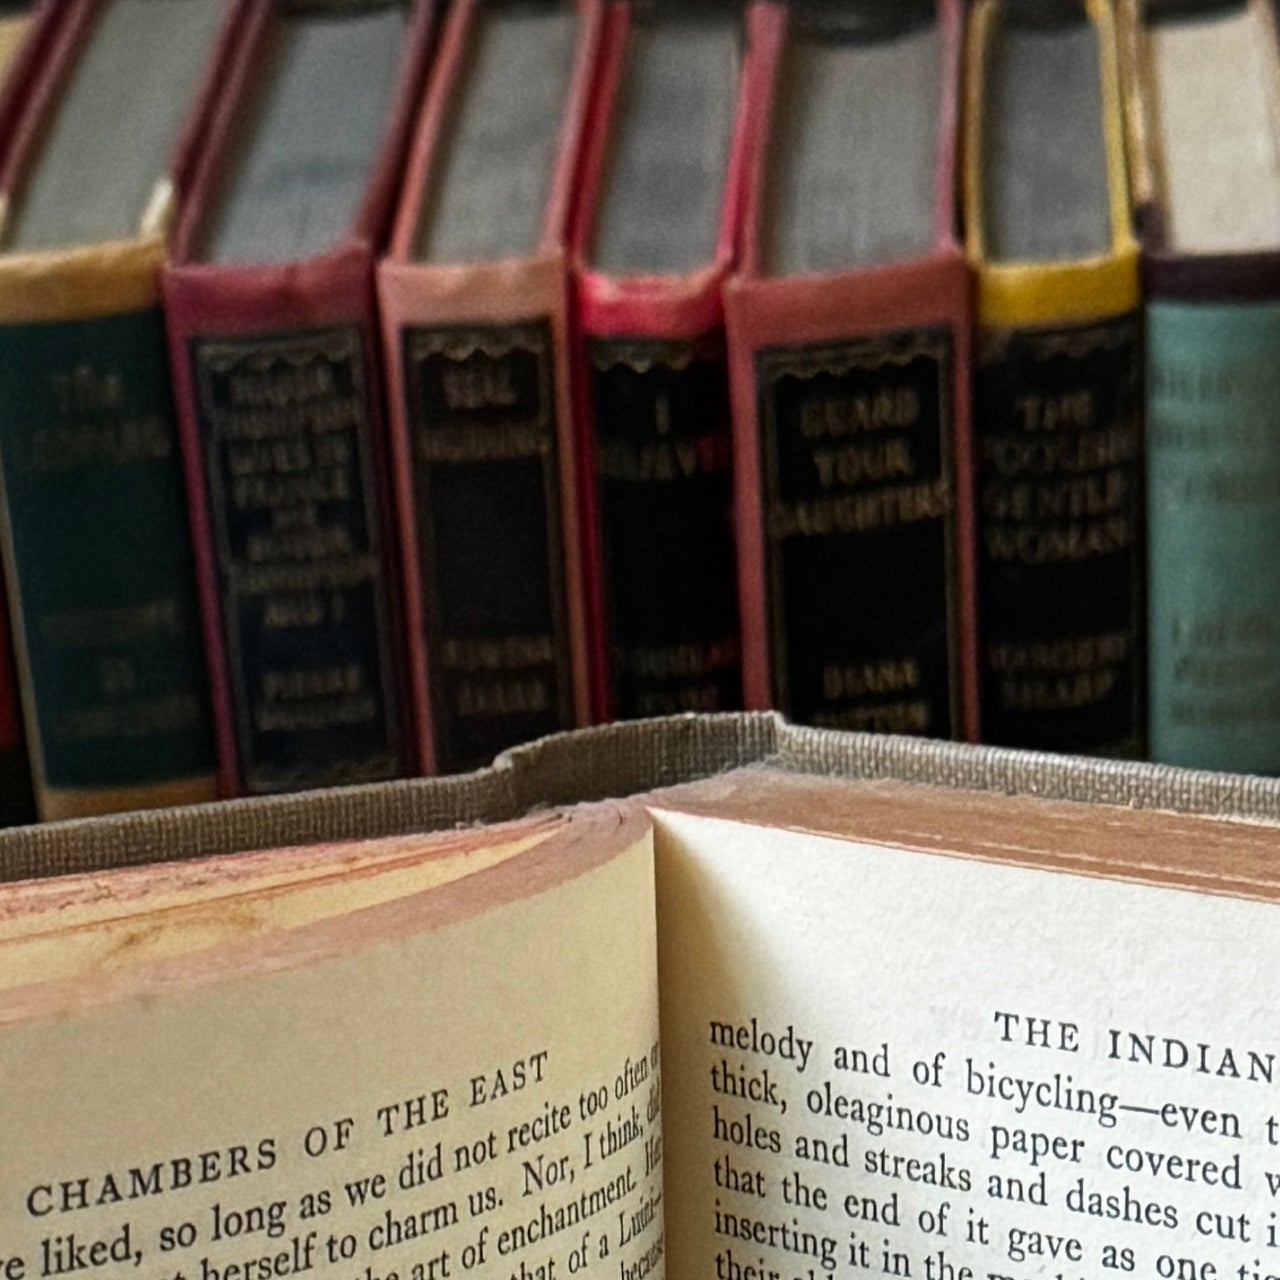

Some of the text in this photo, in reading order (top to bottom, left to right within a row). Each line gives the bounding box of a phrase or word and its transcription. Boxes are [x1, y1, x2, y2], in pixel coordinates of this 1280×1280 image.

[709, 1017, 814, 1074] melody
[833, 1043, 891, 1078] and
[912, 1051, 946, 1088] of
[993, 1010, 1079, 1053] THE
[1108, 1029, 1276, 1084] INDIAN
[26, 1050, 549, 1218] CHAMBERS OF THE EAST
[40, 1222, 143, 1278] liked,
[159, 1222, 198, 1252] so
[210, 1200, 288, 1242] long
[299, 1189, 332, 1220] as
[343, 1174, 387, 1207] we
[398, 1141, 444, 1191] did
[454, 1130, 498, 1173] not
[506, 1101, 572, 1154] recite
[578, 1085, 609, 1122] too
